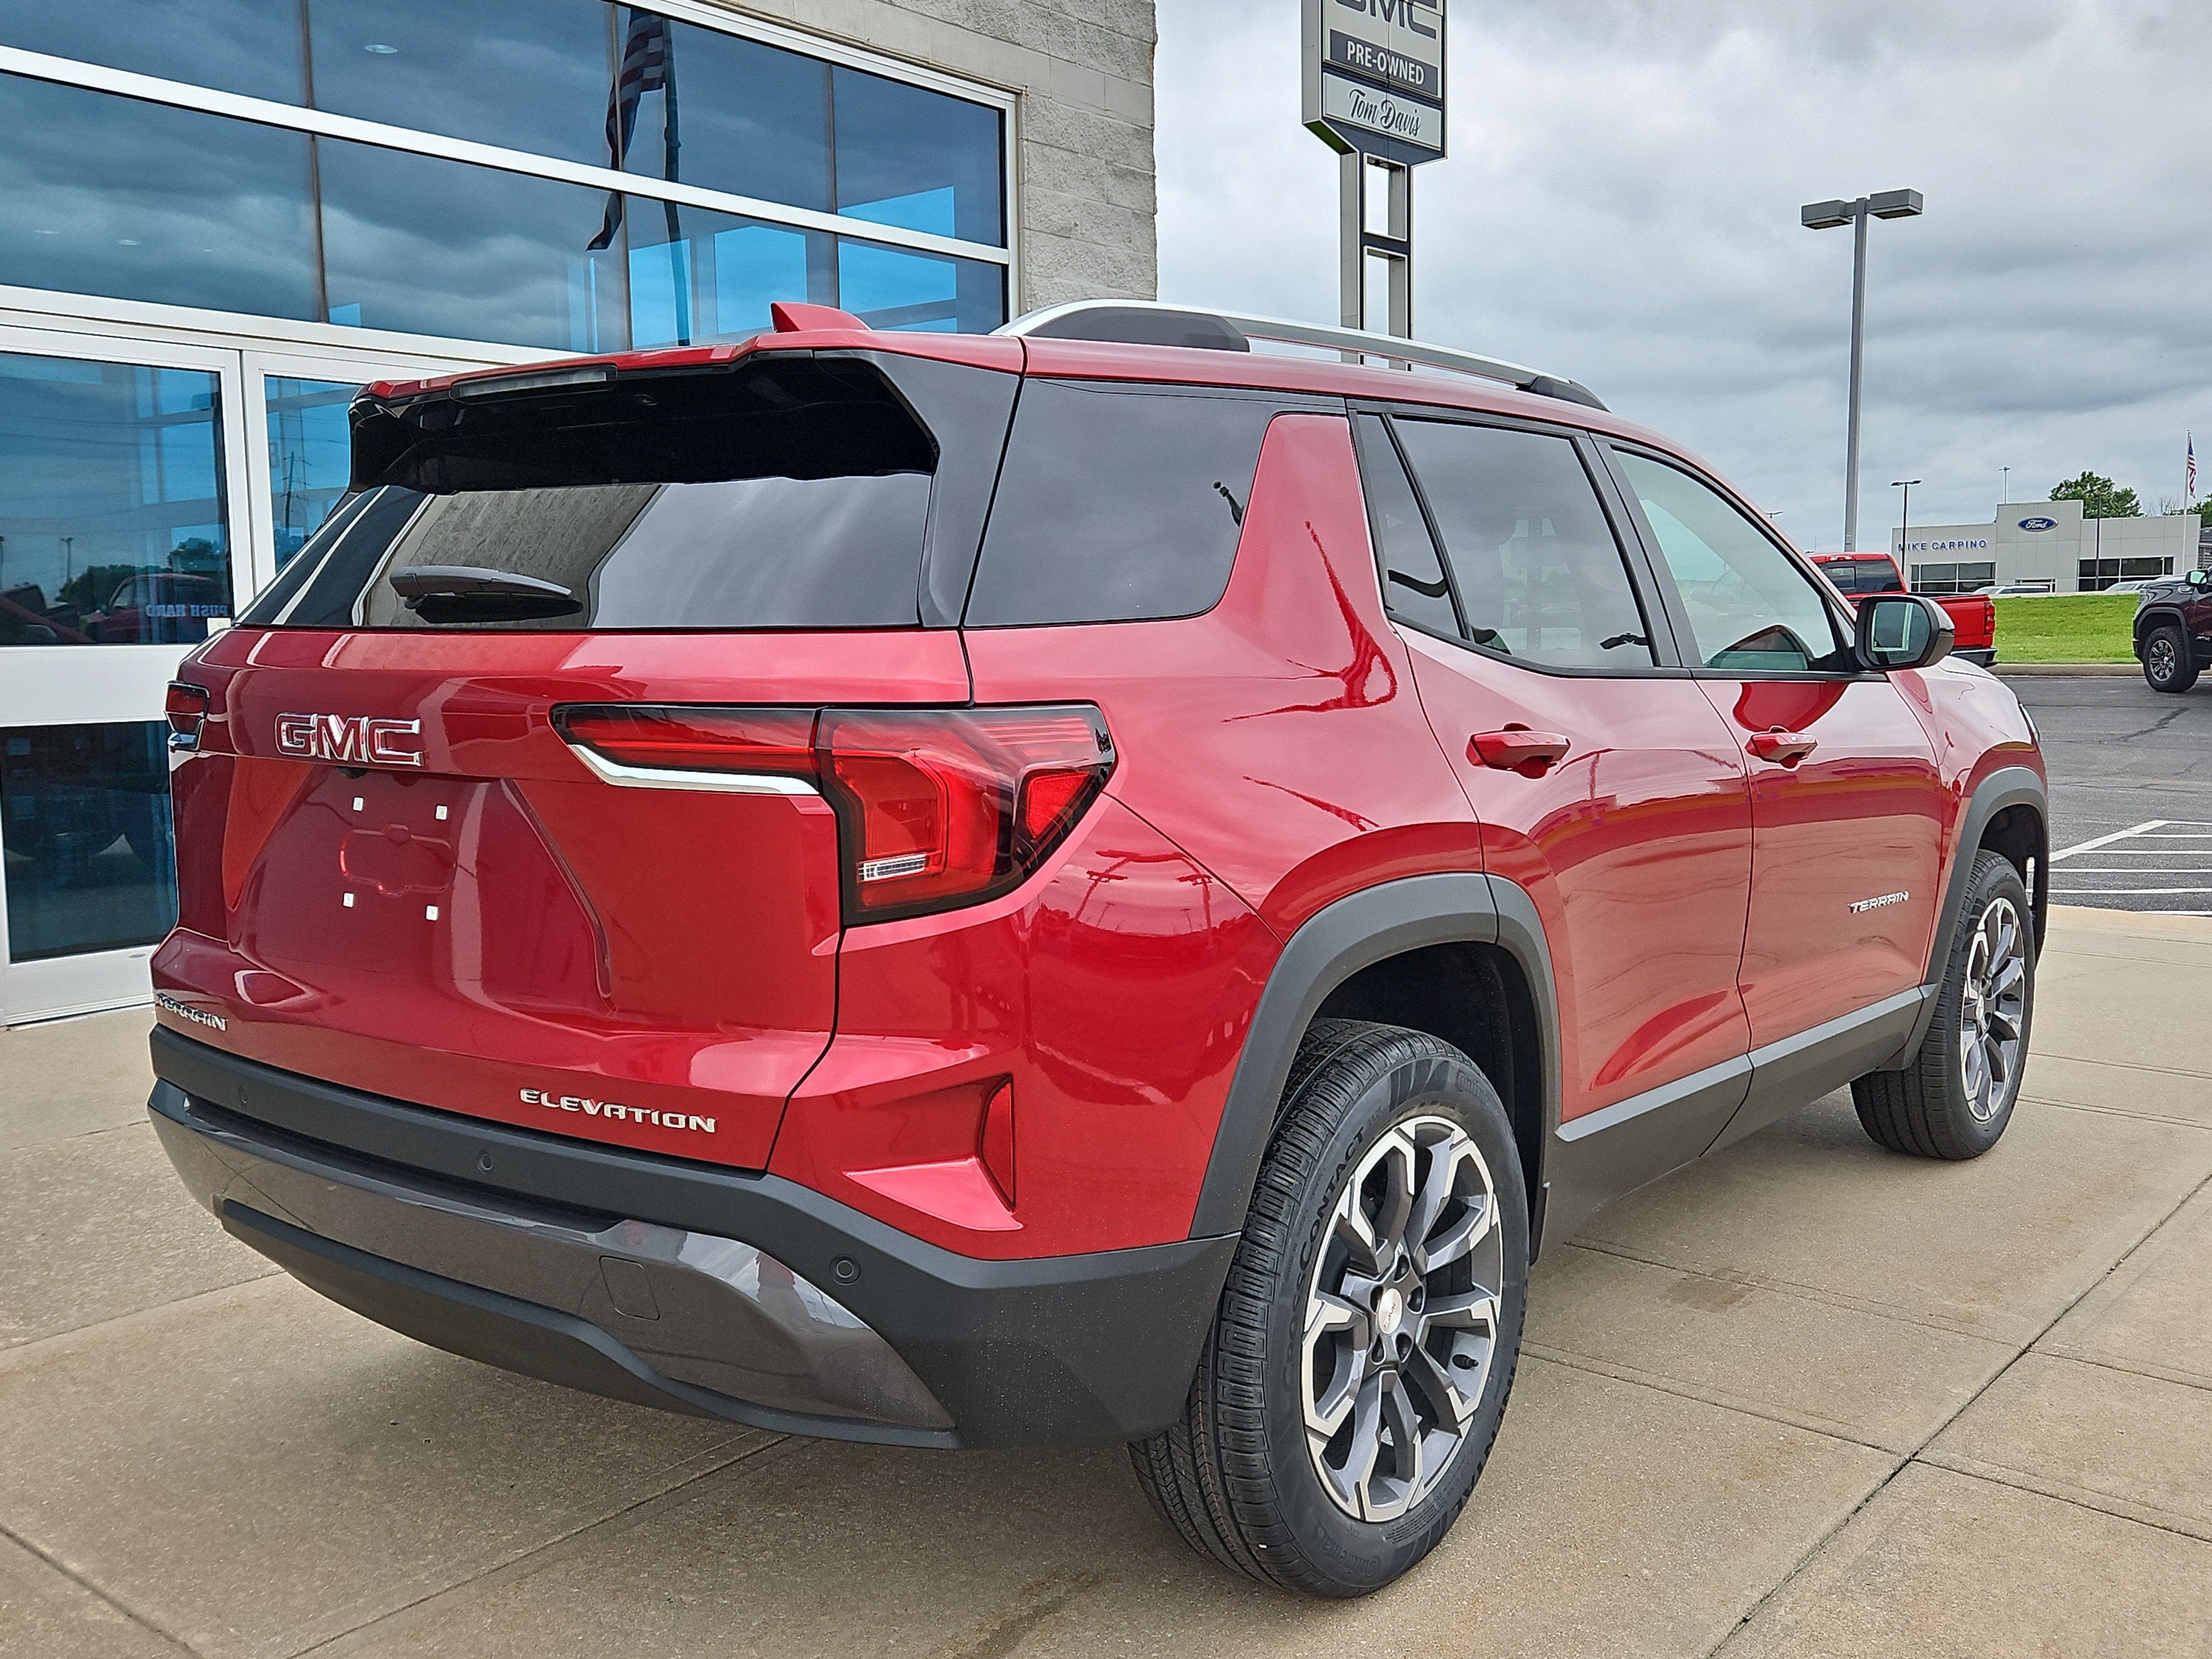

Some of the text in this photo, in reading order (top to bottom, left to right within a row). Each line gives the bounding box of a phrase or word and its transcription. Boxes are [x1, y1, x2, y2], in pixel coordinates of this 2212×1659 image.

[1347, 40, 1425, 85] PRE-OWNED
[1349, 89, 1422, 136] Tom Davis
[1932, 539, 1987, 550] CARPINO
[2025, 518, 2048, 530] Ford
[275, 712, 422, 766] GMC
[1848, 890, 1909, 914] TERRAIN
[520, 1088, 717, 1134] ELEVATION
